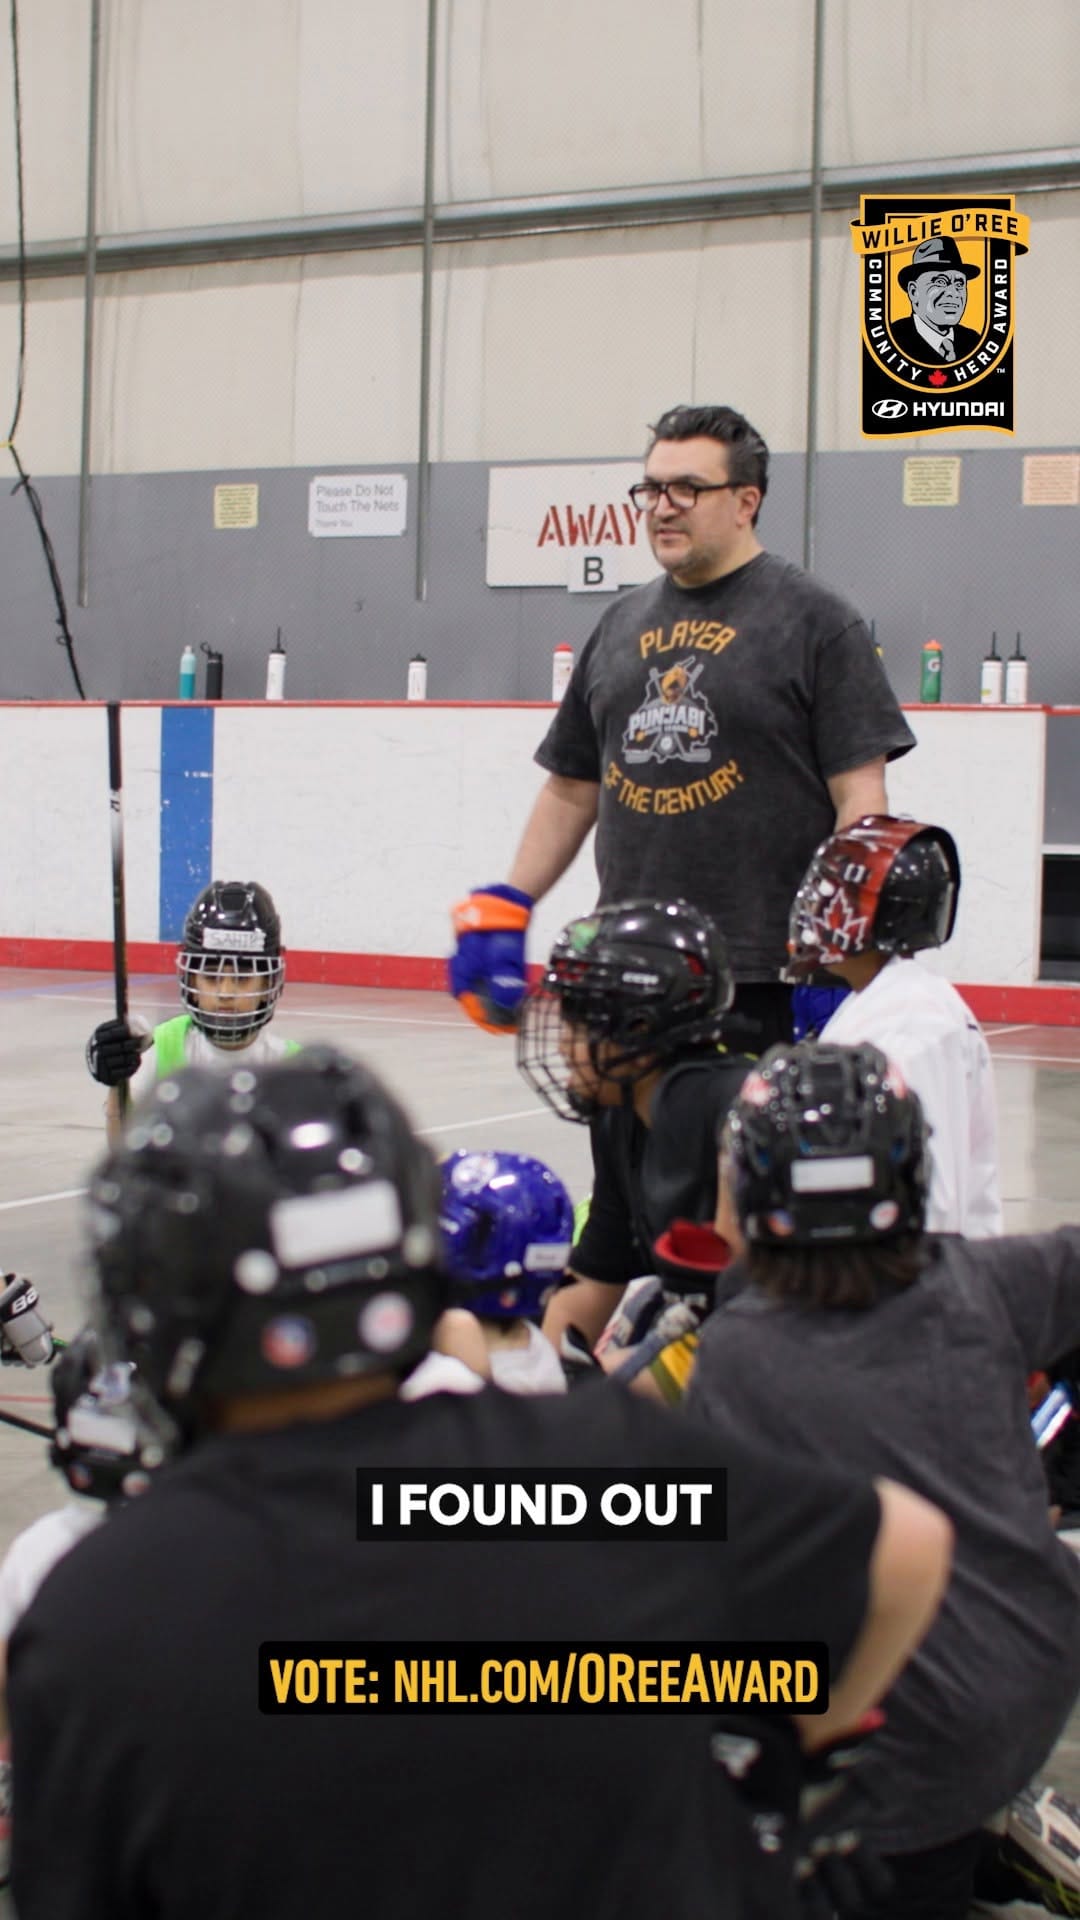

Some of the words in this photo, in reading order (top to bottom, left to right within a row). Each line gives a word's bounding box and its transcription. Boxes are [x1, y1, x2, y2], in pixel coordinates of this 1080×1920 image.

[316, 485, 352, 497] Please
[355, 484, 372, 497] Do
[374, 484, 394, 496] Not
[316, 500, 348, 513] Touch
[351, 500, 372, 513] The
[374, 499, 400, 512] Nets
[537, 503, 643, 548] AWAY
[583, 556, 604, 585] B
[639, 620, 737, 659] PLAYER
[629, 705, 706, 741] PUNJABI
[617, 778, 652, 813] THE
[653, 759, 744, 815] CENTURY
